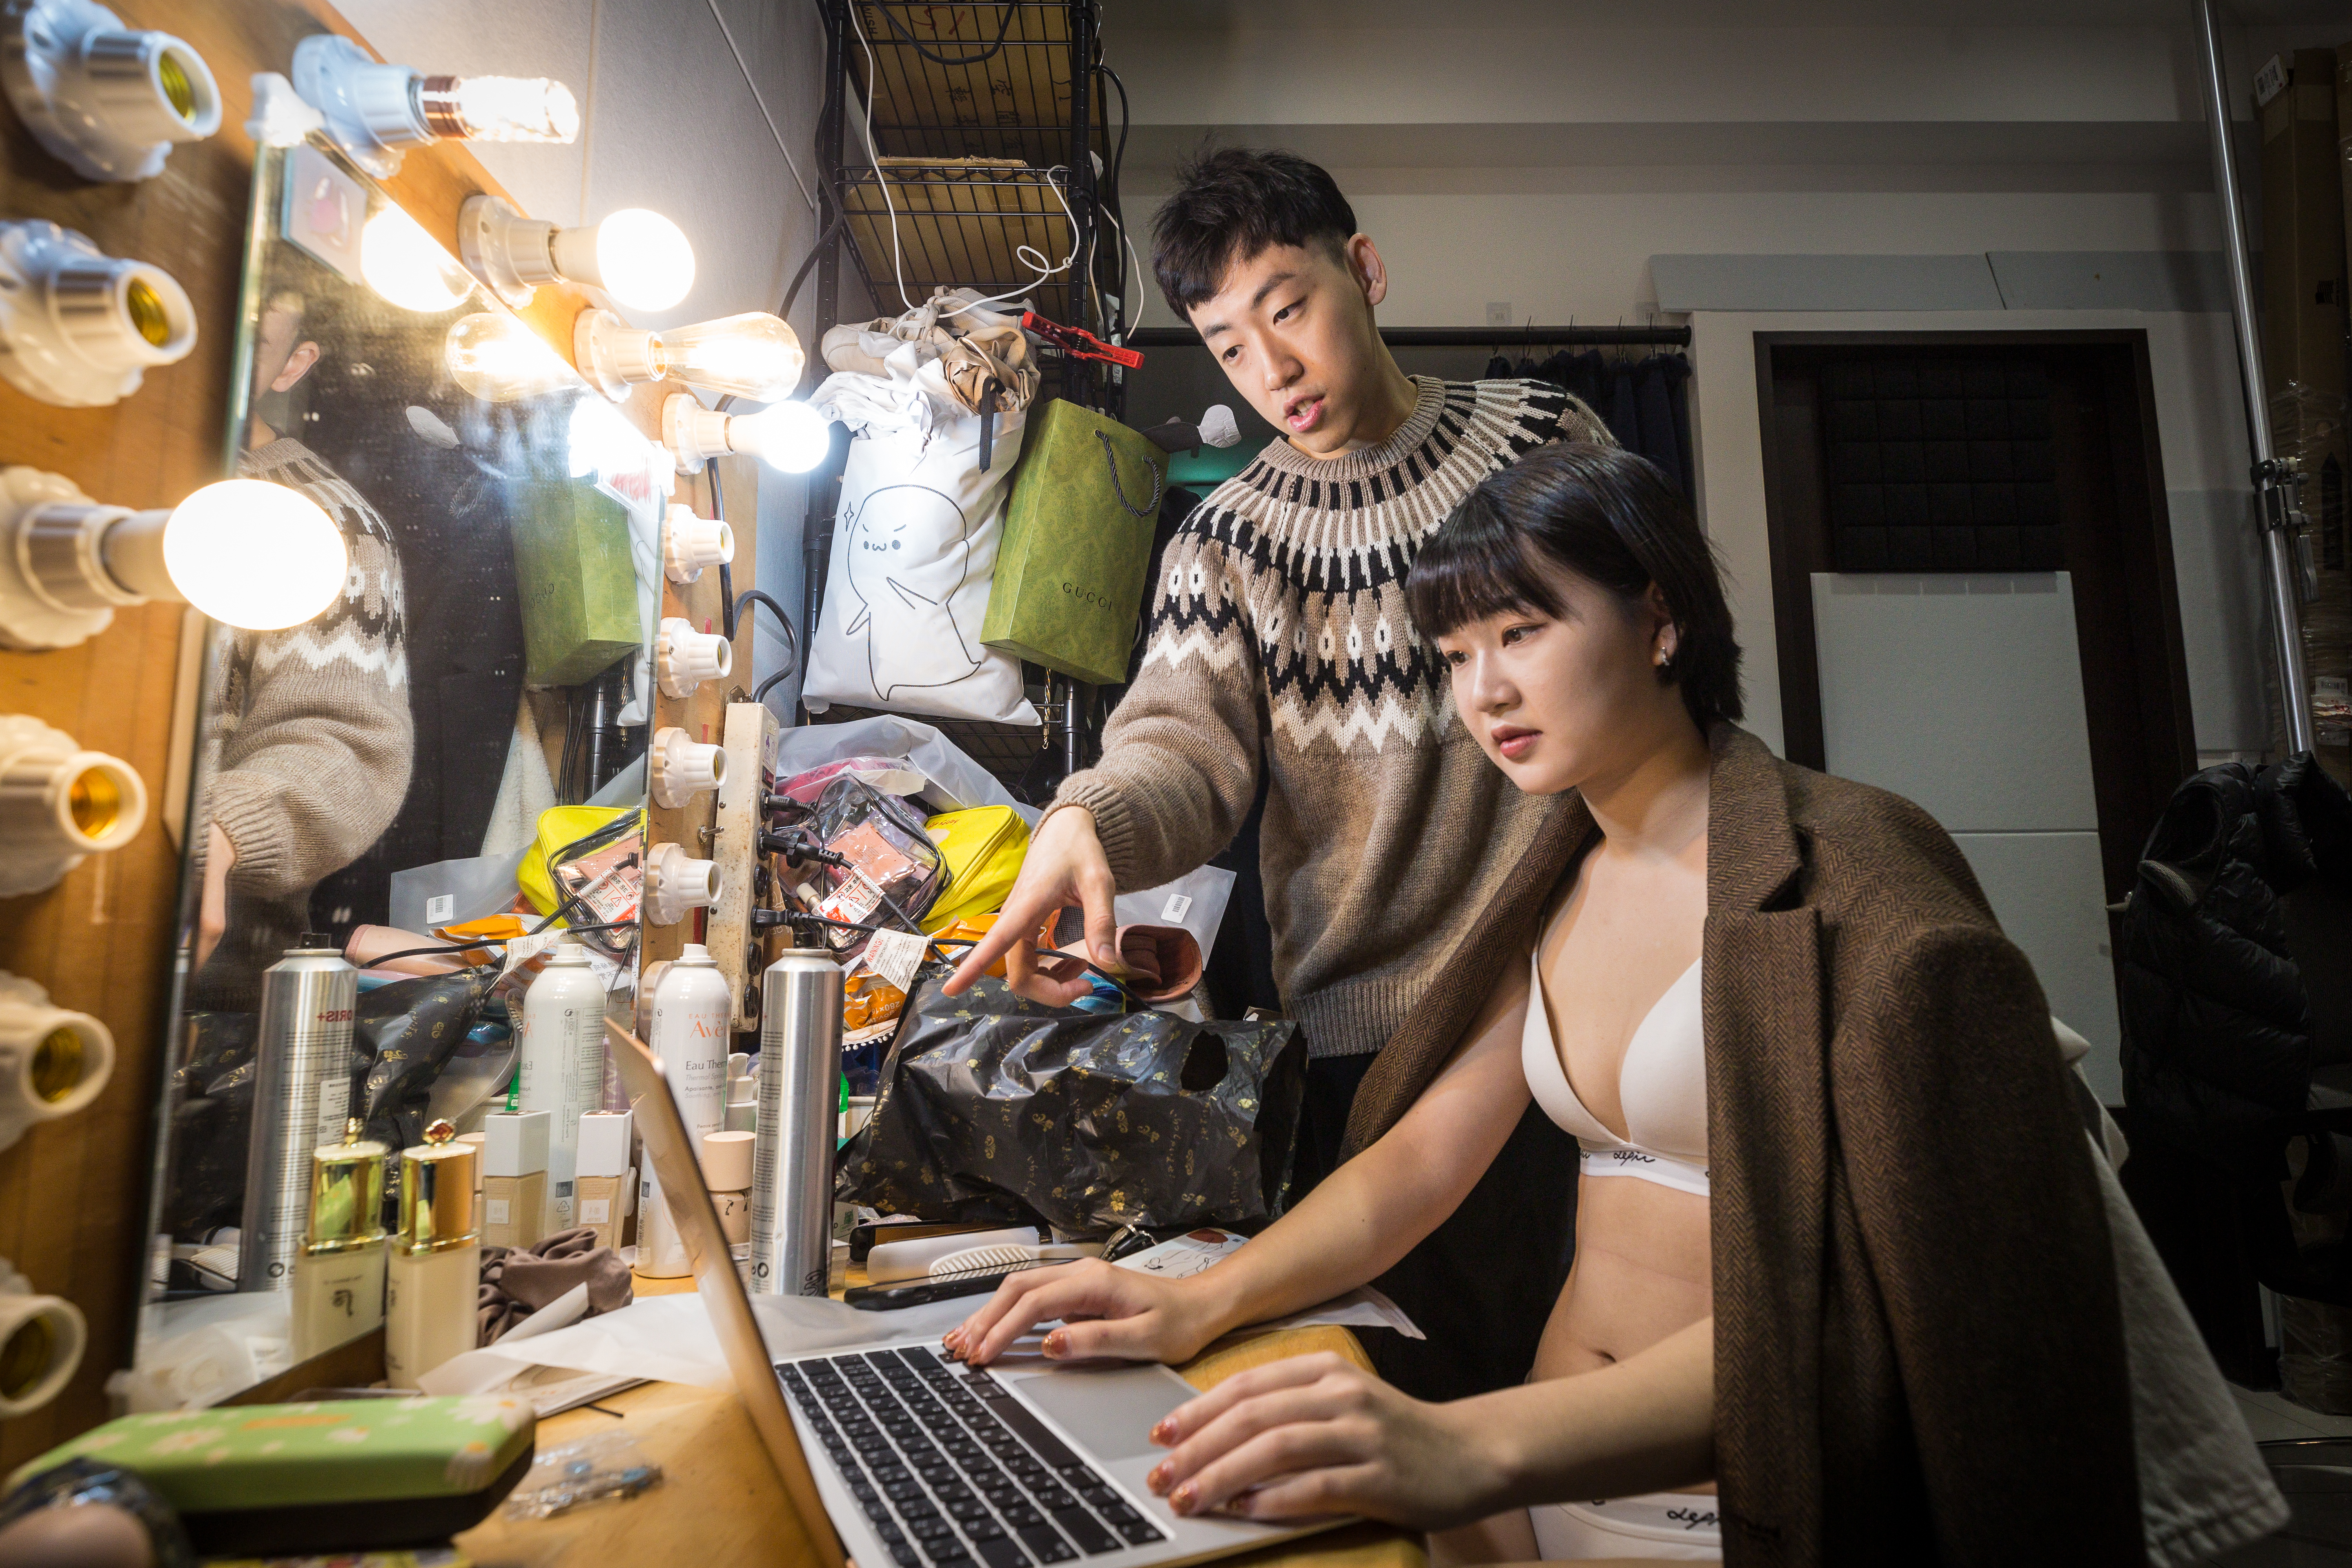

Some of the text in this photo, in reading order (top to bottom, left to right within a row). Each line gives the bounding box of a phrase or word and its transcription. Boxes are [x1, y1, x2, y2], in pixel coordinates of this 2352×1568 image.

[1062, 582, 1112, 611] GUCCI
[844, 884, 853, 893] 고온
[866, 938, 884, 962] WARNING!
[686, 1061, 704, 1070] Eau
